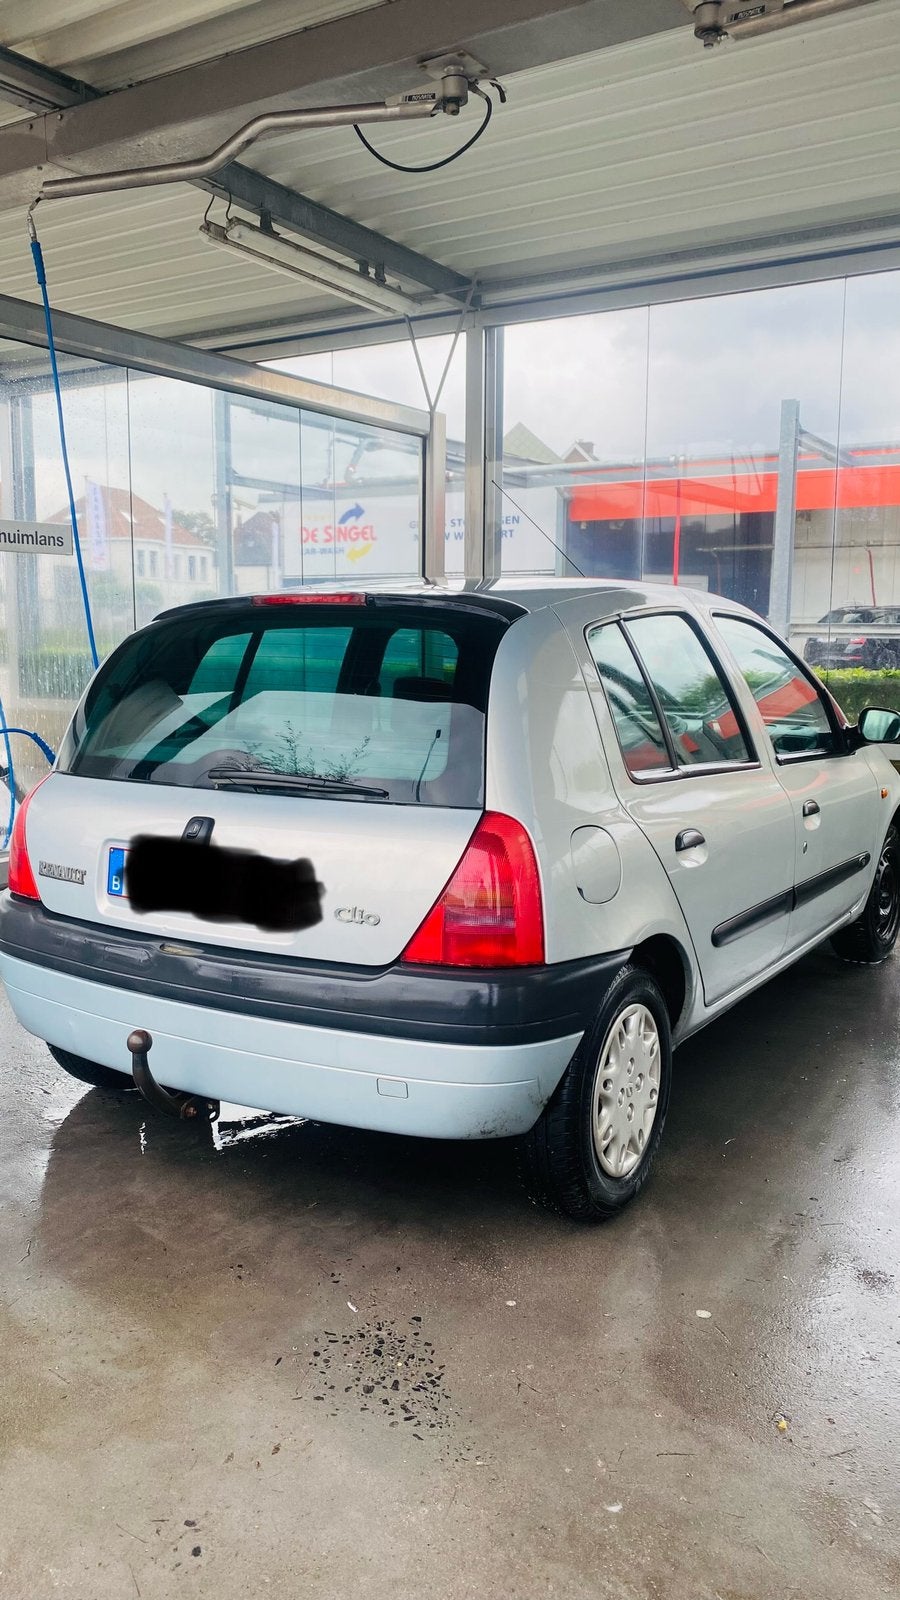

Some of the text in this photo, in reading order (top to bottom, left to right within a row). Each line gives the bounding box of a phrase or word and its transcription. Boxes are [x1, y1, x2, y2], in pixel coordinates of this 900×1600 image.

[299, 526, 318, 544] DE
[38, 860, 87, 885] RENAULT
[112, 875, 120, 890] B
[334, 906, 381, 926] Clio
